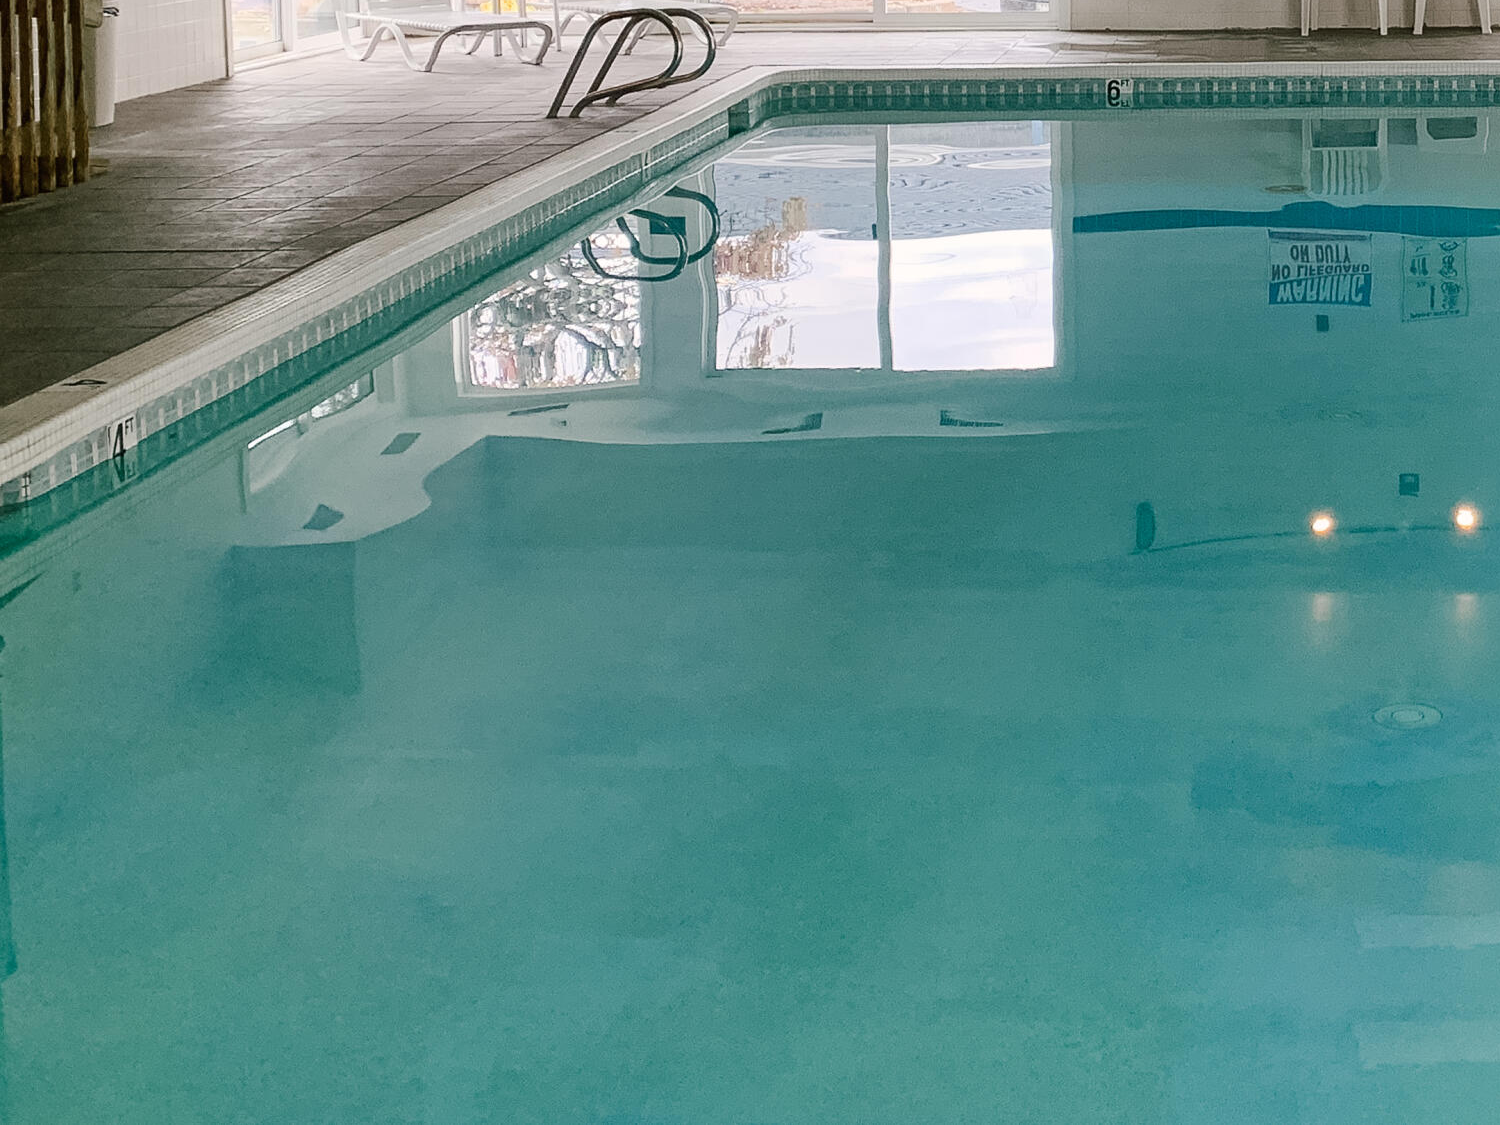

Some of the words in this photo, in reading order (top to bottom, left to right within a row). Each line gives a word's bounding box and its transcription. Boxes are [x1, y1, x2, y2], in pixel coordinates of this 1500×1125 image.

[1107, 79, 1120, 102] 6
[1121, 79, 1129, 87] FT
[112, 422, 127, 459] 4
[124, 416, 134, 435] FT
